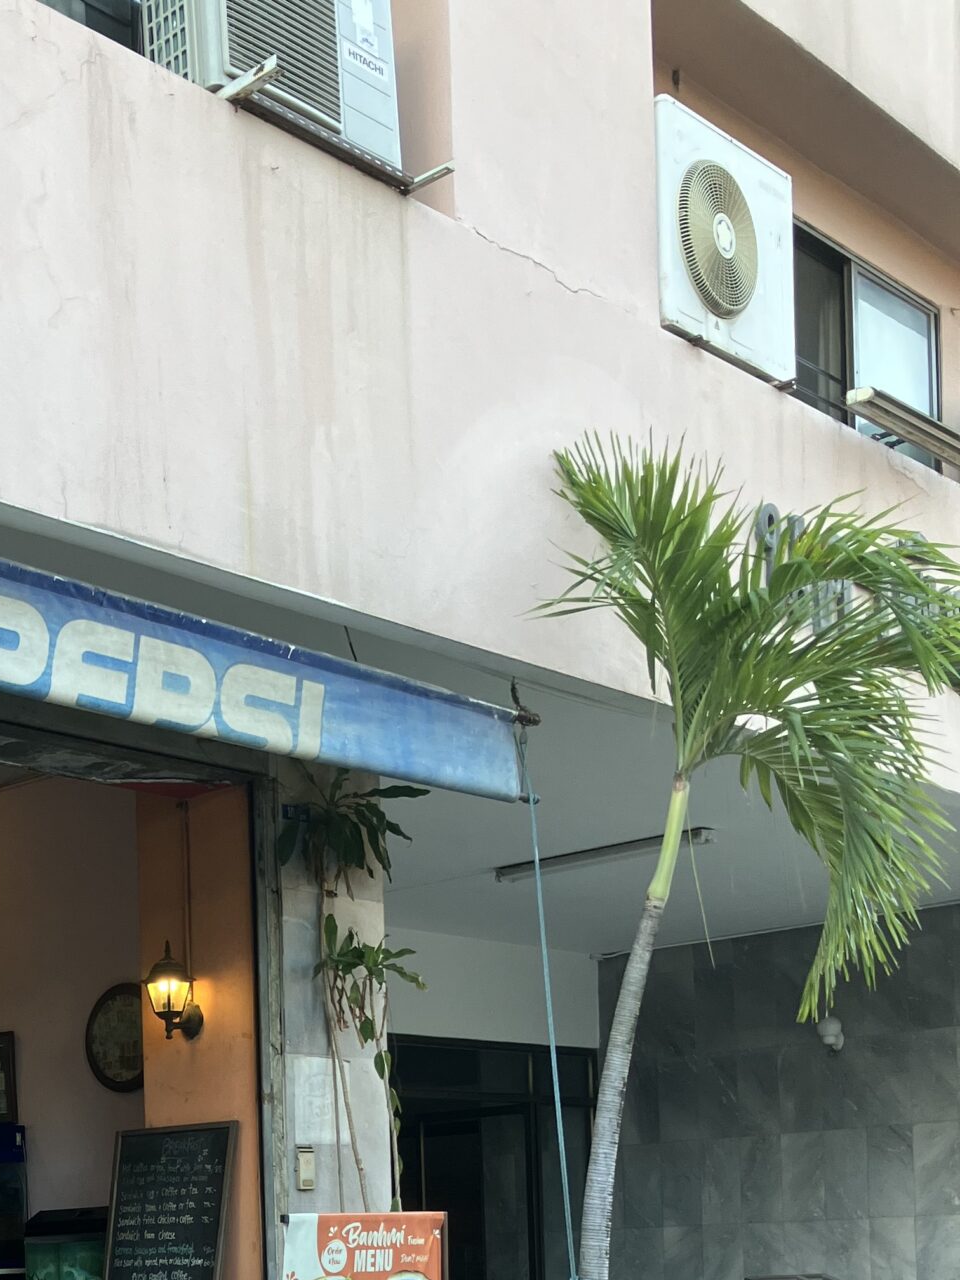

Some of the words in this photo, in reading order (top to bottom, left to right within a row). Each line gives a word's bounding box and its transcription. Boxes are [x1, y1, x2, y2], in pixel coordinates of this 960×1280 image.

[348, 48, 384, 76] HITACHI
[342, 1222, 406, 1248] Banhmi
[354, 1248, 393, 1272] MENU
